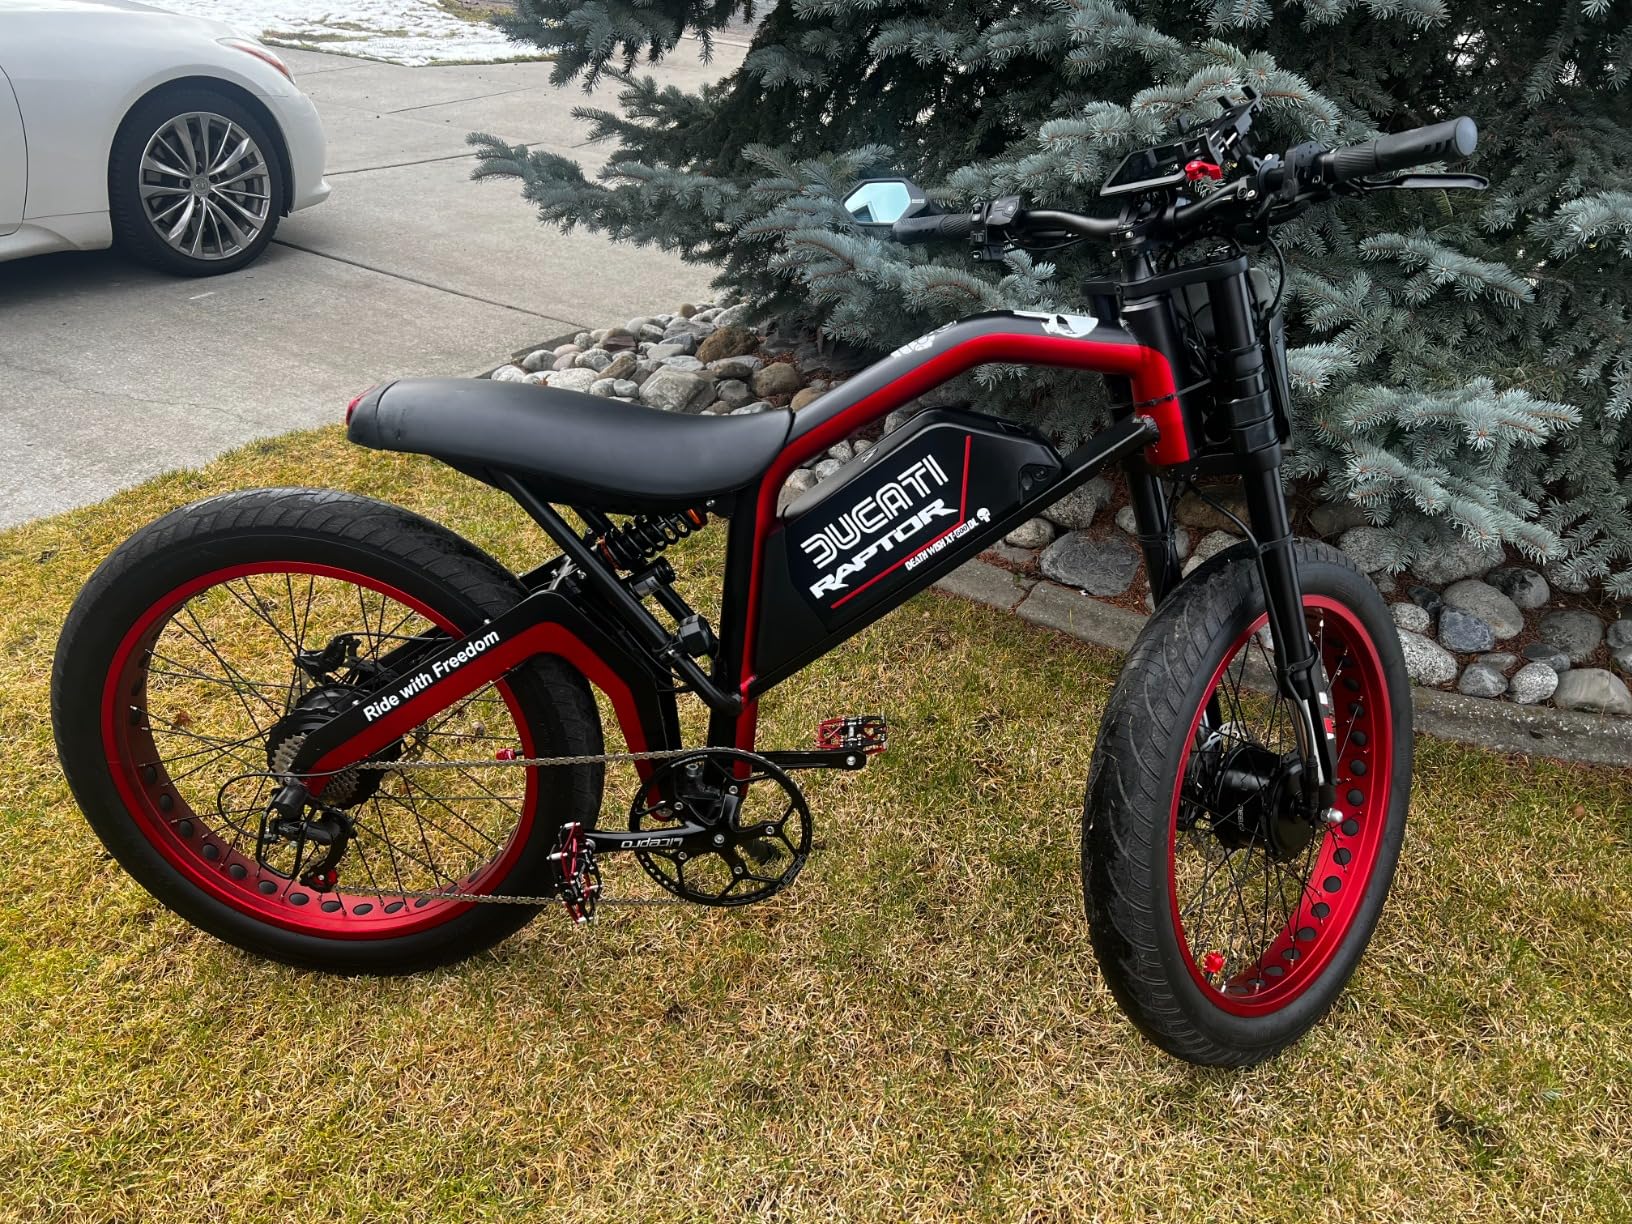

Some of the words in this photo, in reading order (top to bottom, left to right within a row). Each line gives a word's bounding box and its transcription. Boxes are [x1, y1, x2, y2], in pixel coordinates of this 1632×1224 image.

[800, 454, 948, 569] DUCATI
[809, 498, 958, 599] RAPTOR
[904, 550, 929, 571] DEATH
[926, 538, 947, 556] WISH
[363, 695, 400, 722] Ride
[400, 672, 433, 699] with
[431, 631, 500, 678] Freedom
